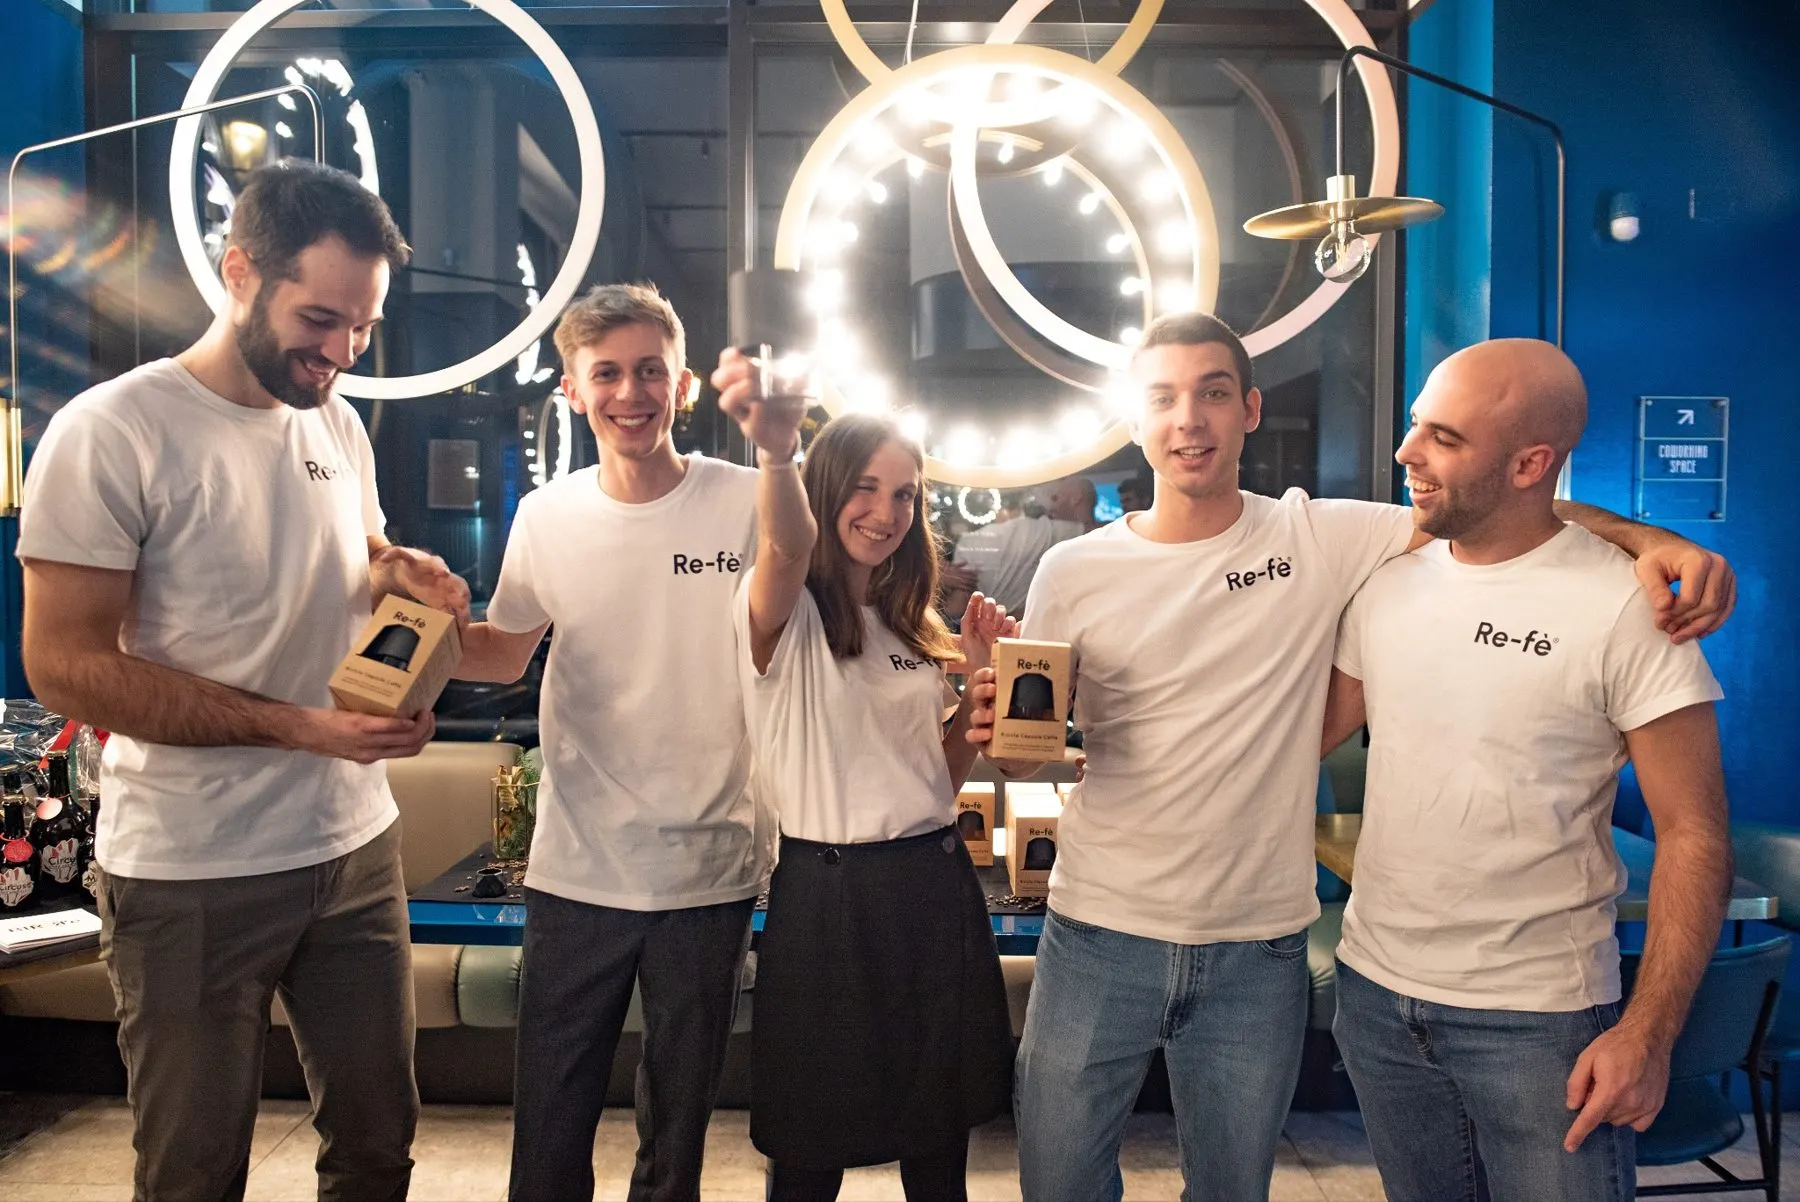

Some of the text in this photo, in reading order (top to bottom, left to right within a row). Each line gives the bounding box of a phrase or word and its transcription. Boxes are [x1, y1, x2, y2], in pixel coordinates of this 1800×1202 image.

[1669, 460, 1697, 474] SPACE
[673, 551, 742, 575] Re-fè
[1225, 556, 1291, 592] Re-fè
